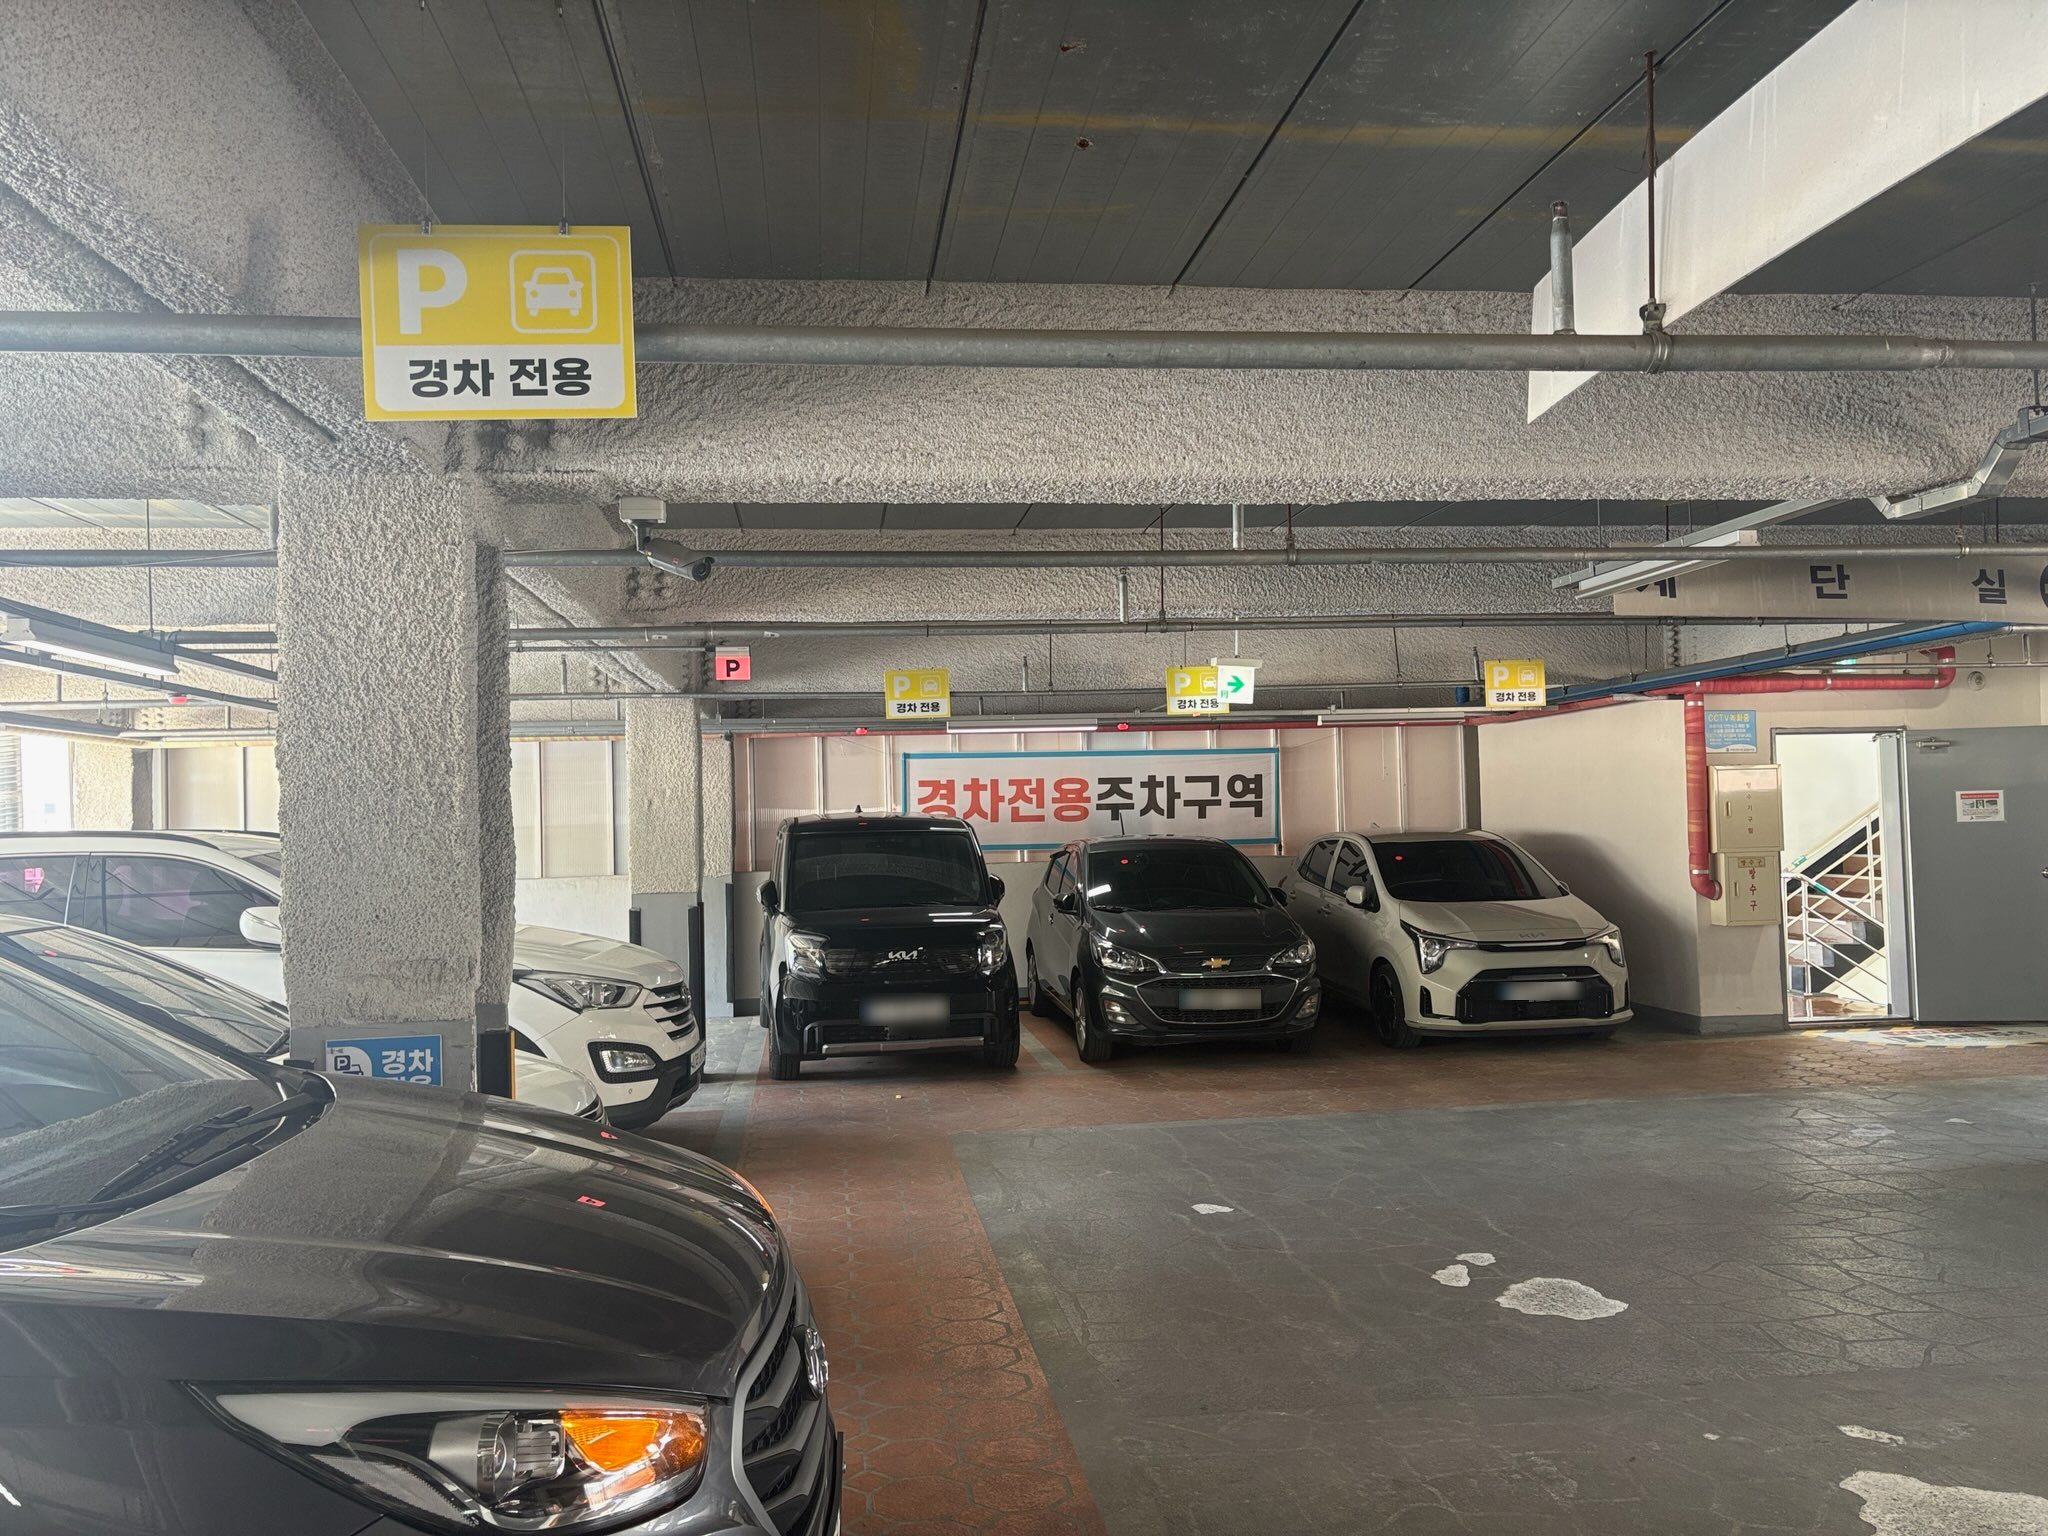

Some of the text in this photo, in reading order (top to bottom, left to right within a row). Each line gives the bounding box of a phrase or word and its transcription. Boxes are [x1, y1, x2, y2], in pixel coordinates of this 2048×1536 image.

[397, 248, 467, 335] P
[408, 357, 592, 398] 경차 전용
[726, 659, 740, 677] P
[1492, 665, 1509, 687] P
[892, 675, 910, 698] P
[1174, 671, 1191, 694] P
[896, 701, 940, 713] 경차 전용
[1177, 698, 1219, 709] 경차 전용
[1495, 691, 1537, 703] 경차 전용
[381, 1049, 433, 1074] 경차
